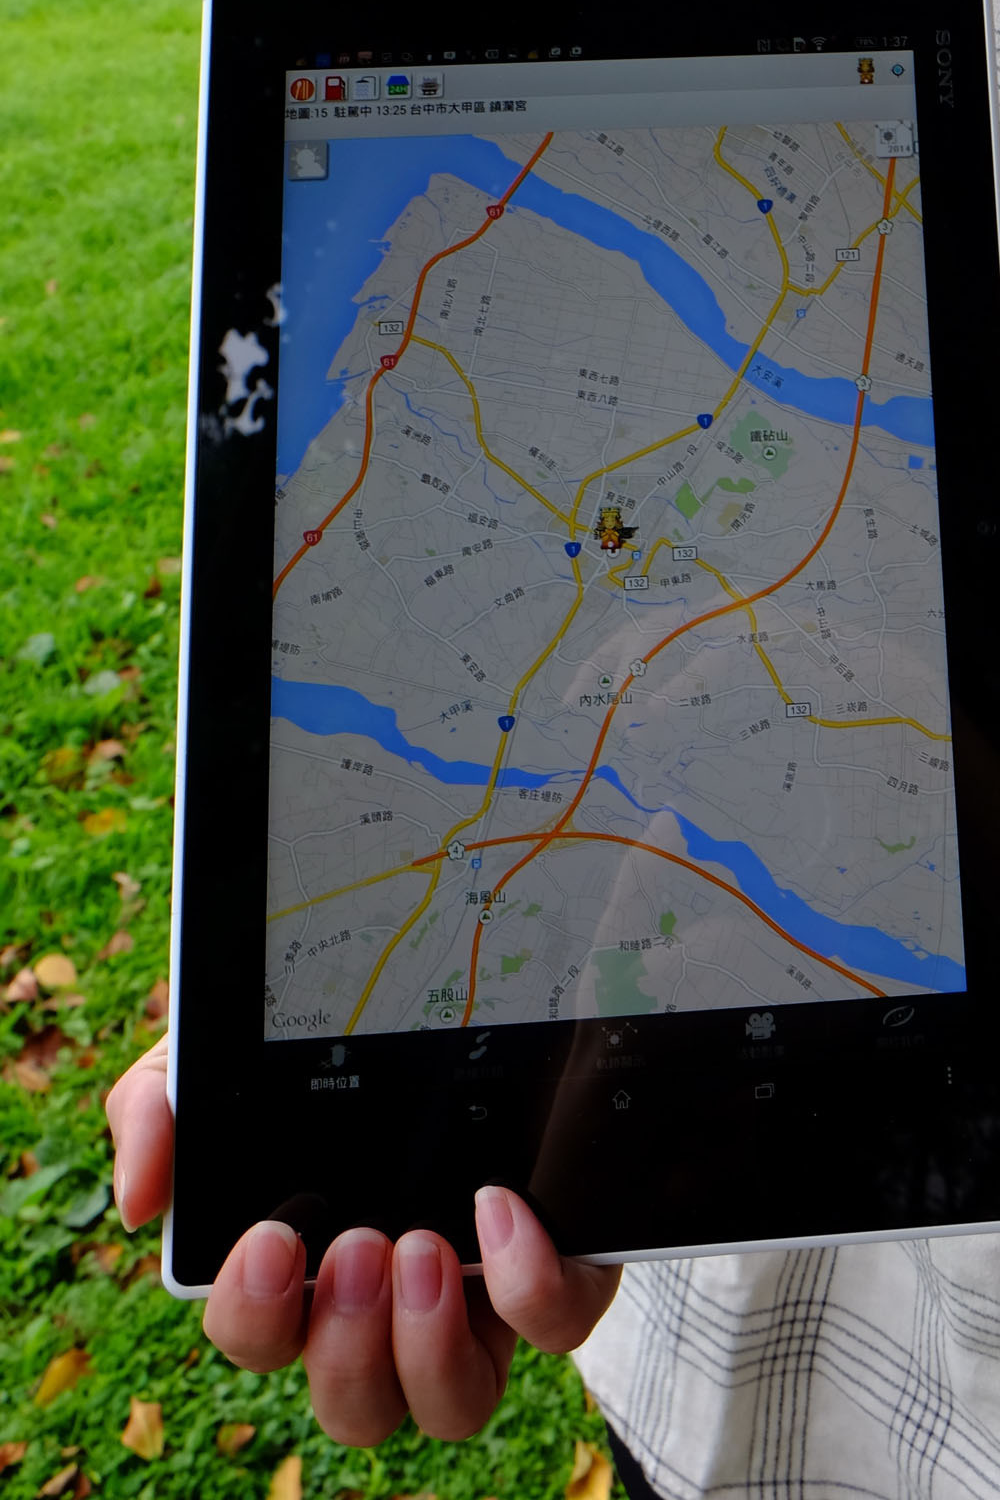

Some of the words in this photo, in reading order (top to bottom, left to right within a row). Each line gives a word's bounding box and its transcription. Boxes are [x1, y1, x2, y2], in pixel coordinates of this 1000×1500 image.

[936, 29, 953, 108] SONY
[285, 108, 328, 120] 地圖:15
[334, 106, 372, 118] 駐駕中
[376, 104, 407, 116] 13:25
[410, 102, 486, 116] 台中市大甲區
[489, 100, 527, 112] 鎮瀾宮
[489, 208, 501, 217] 61
[840, 251, 856, 260] 121
[384, 324, 400, 332] 132
[384, 358, 395, 366] 61
[578, 368, 620, 386] 東西七路
[752, 364, 784, 388] 大安溪
[576, 389, 619, 406] 東西八路
[750, 428, 788, 442] 鐵砧山
[306, 533, 318, 542] 61
[678, 550, 694, 558] 132
[628, 578, 645, 588] 132
[816, 607, 832, 640] 中山路
[438, 699, 474, 725] 大甲溪
[790, 706, 807, 714] 132
[465, 890, 507, 905] 海風山
[427, 987, 468, 1004] 五股山
[272, 1008, 332, 1032] Google
[310, 1075, 360, 1091] 即時位置
